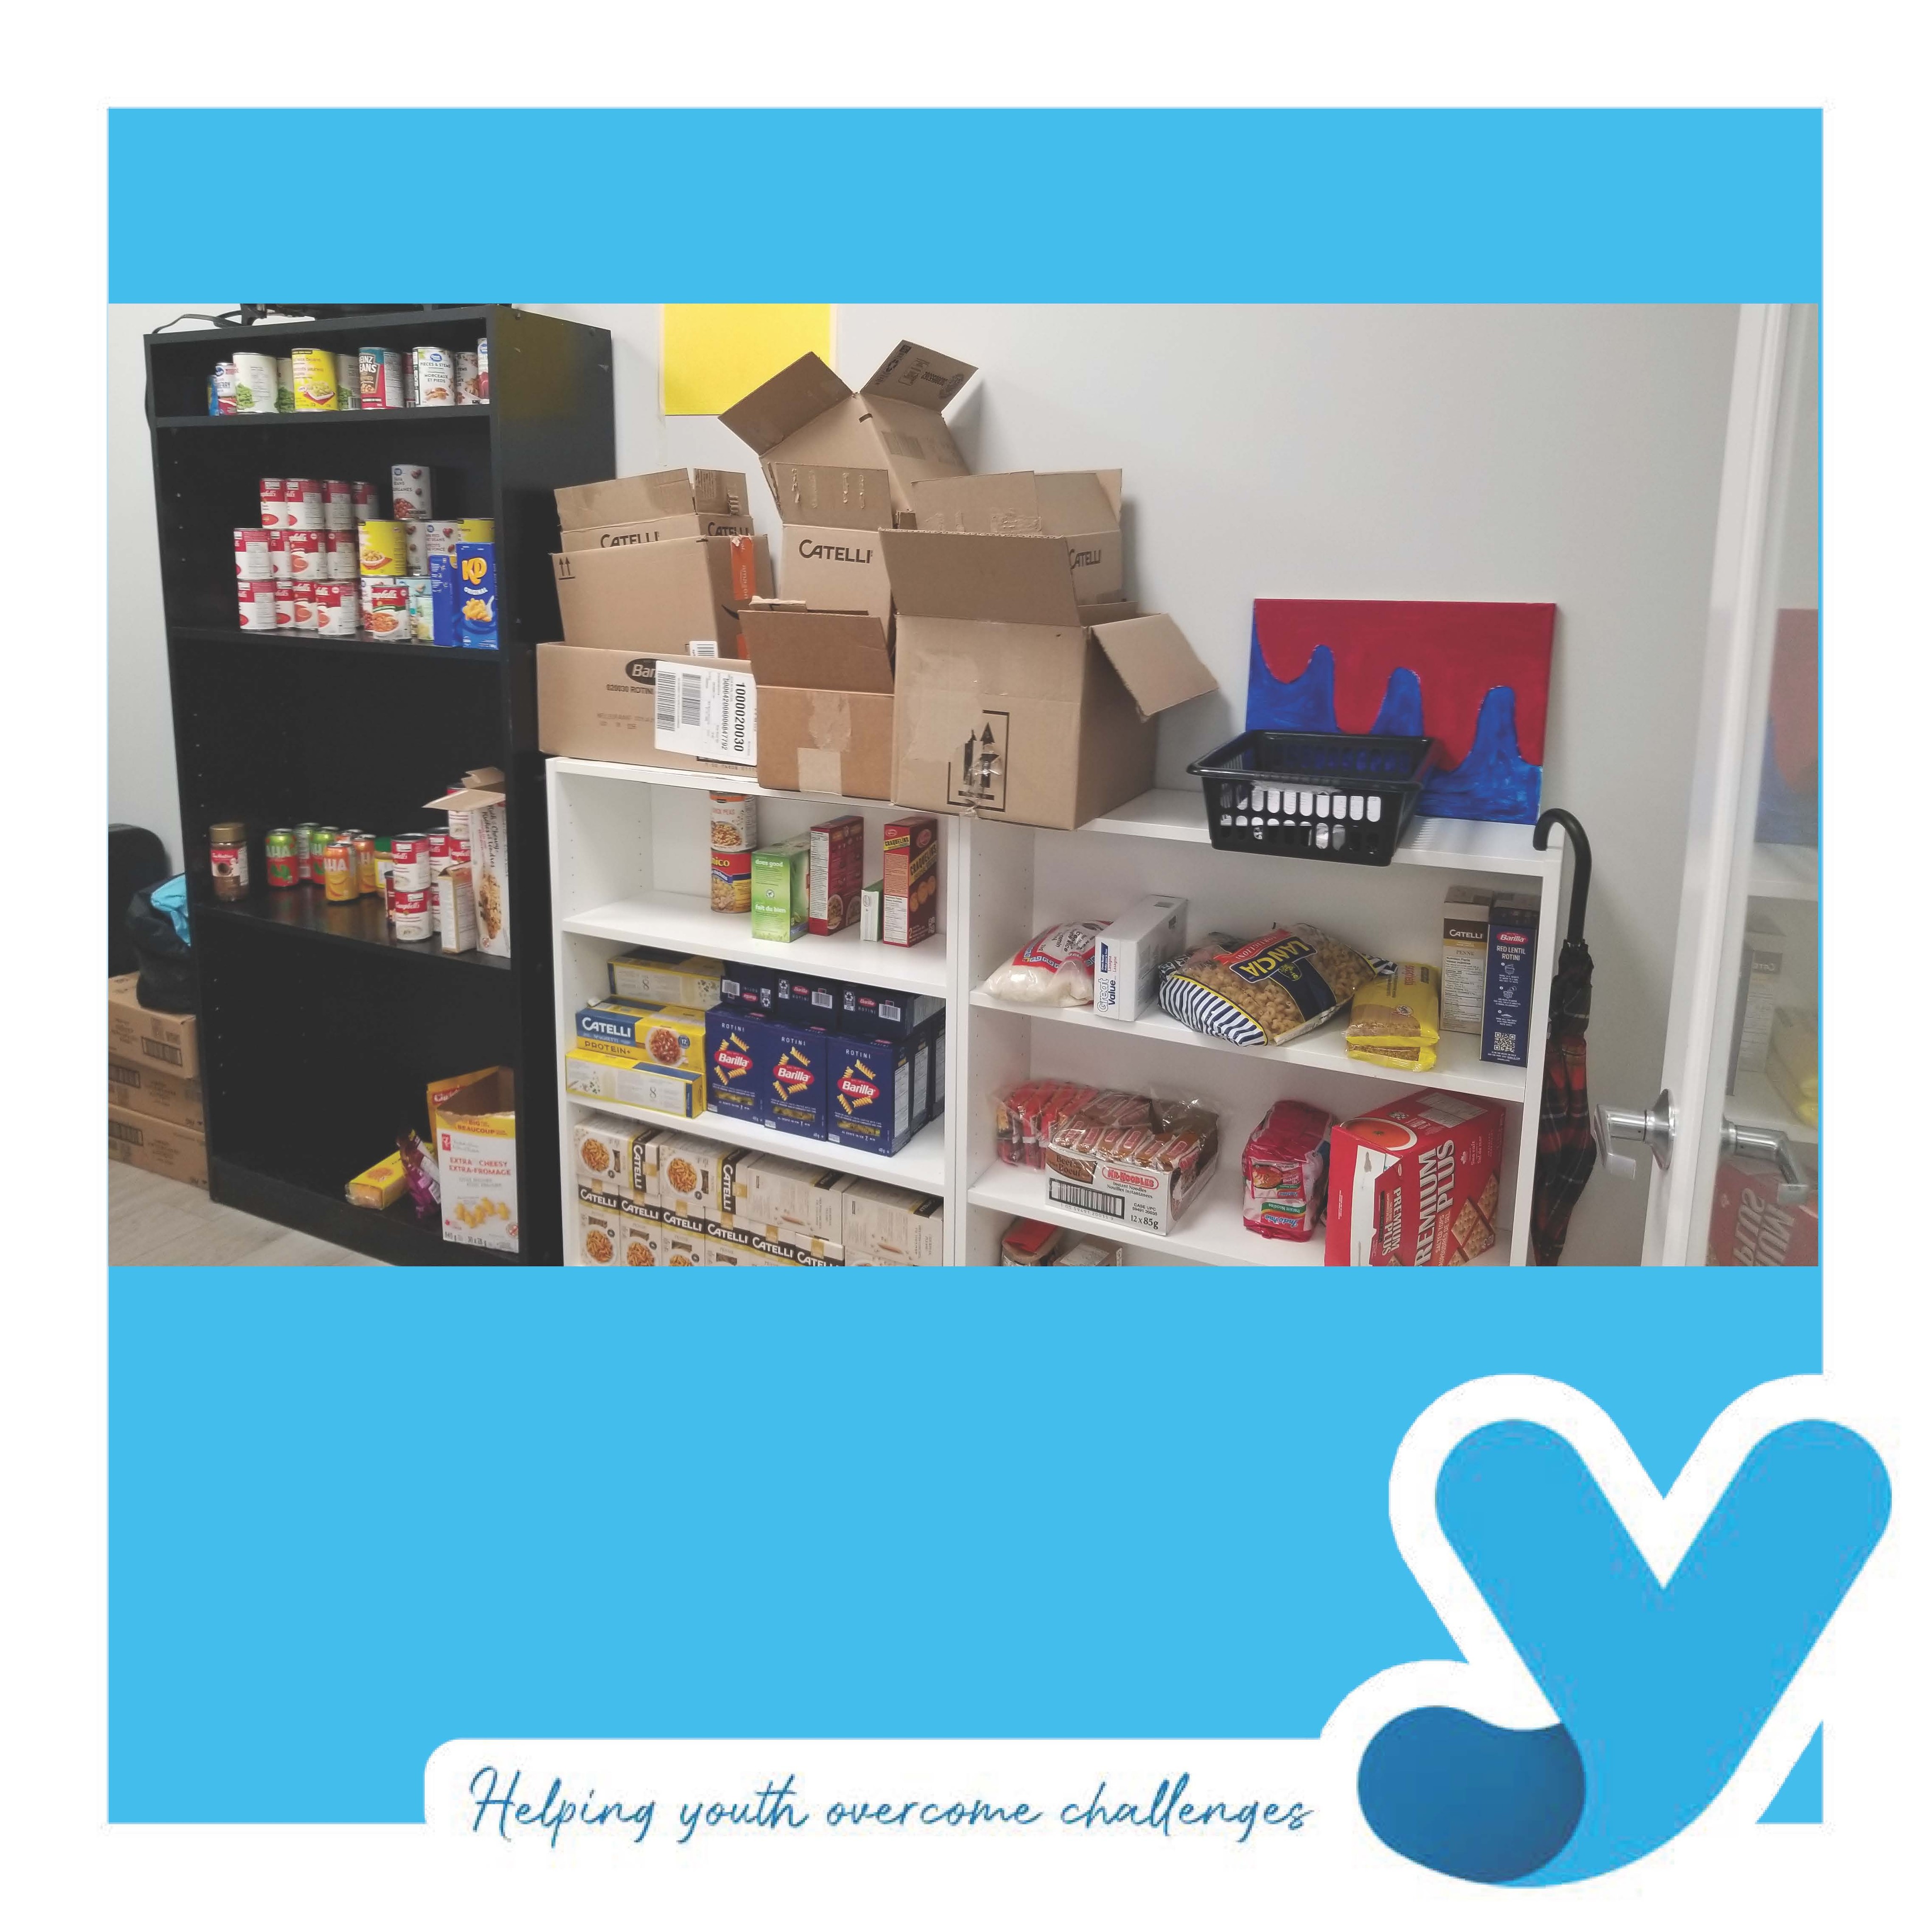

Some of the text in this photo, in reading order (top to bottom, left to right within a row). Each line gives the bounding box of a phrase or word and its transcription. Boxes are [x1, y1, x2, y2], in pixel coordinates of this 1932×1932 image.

[799, 539, 873, 564] CATELLI
[1069, 549, 1101, 569] CATELLI
[734, 682, 746, 752] 1000020030
[712, 856, 730, 867] nico
[1449, 929, 1482, 939] CATELLI
[1500, 934, 1524, 942] Barilla
[1502, 953, 1520, 961] ROTINI
[1508, 946, 1526, 954] LENTIL
[1239, 940, 1310, 977] LANCIA
[1097, 978, 1109, 1013] Great
[582, 1017, 631, 1038] CATELLI
[722, 1023, 745, 1032] ROTINI
[585, 1041, 631, 1054] PROTEIN+
[781, 1036, 806, 1046] ROTINI
[719, 1053, 748, 1067] Barilla
[846, 1049, 871, 1059] ROTINI
[778, 1067, 809, 1082] Barilla
[842, 1081, 874, 1096] Barilla
[457, 1125, 495, 1134] BEAUCOUP
[450, 1157, 472, 1165] EXTRA
[633, 1144, 643, 1189] CATELLI
[1056, 1155, 1073, 1166] Beef
[449, 1165, 511, 1175] EXTRA-FROMAGE
[1436, 1139, 1455, 1213] PLUS
[723, 1164, 733, 1211] CATELLI
[1120, 1173, 1154, 1187] NOODLES
[1129, 1185, 1147, 1193] Noodles
[580, 1188, 617, 1208] CATELLI
[621, 1200, 659, 1220] CATELLI
[1415, 1148, 1437, 1266] REMIUM
[663, 1212, 702, 1232] CATELLI
[1391, 1187, 1402, 1252] PREMIUM
[707, 1224, 748, 1244] CATELLI
[1443, 1224, 1449, 1232] DE
[1382, 1222, 1393, 1256] PLUS
[1435, 1231, 1443, 1253] SALTED
[752, 1237, 794, 1258] CATELLI
